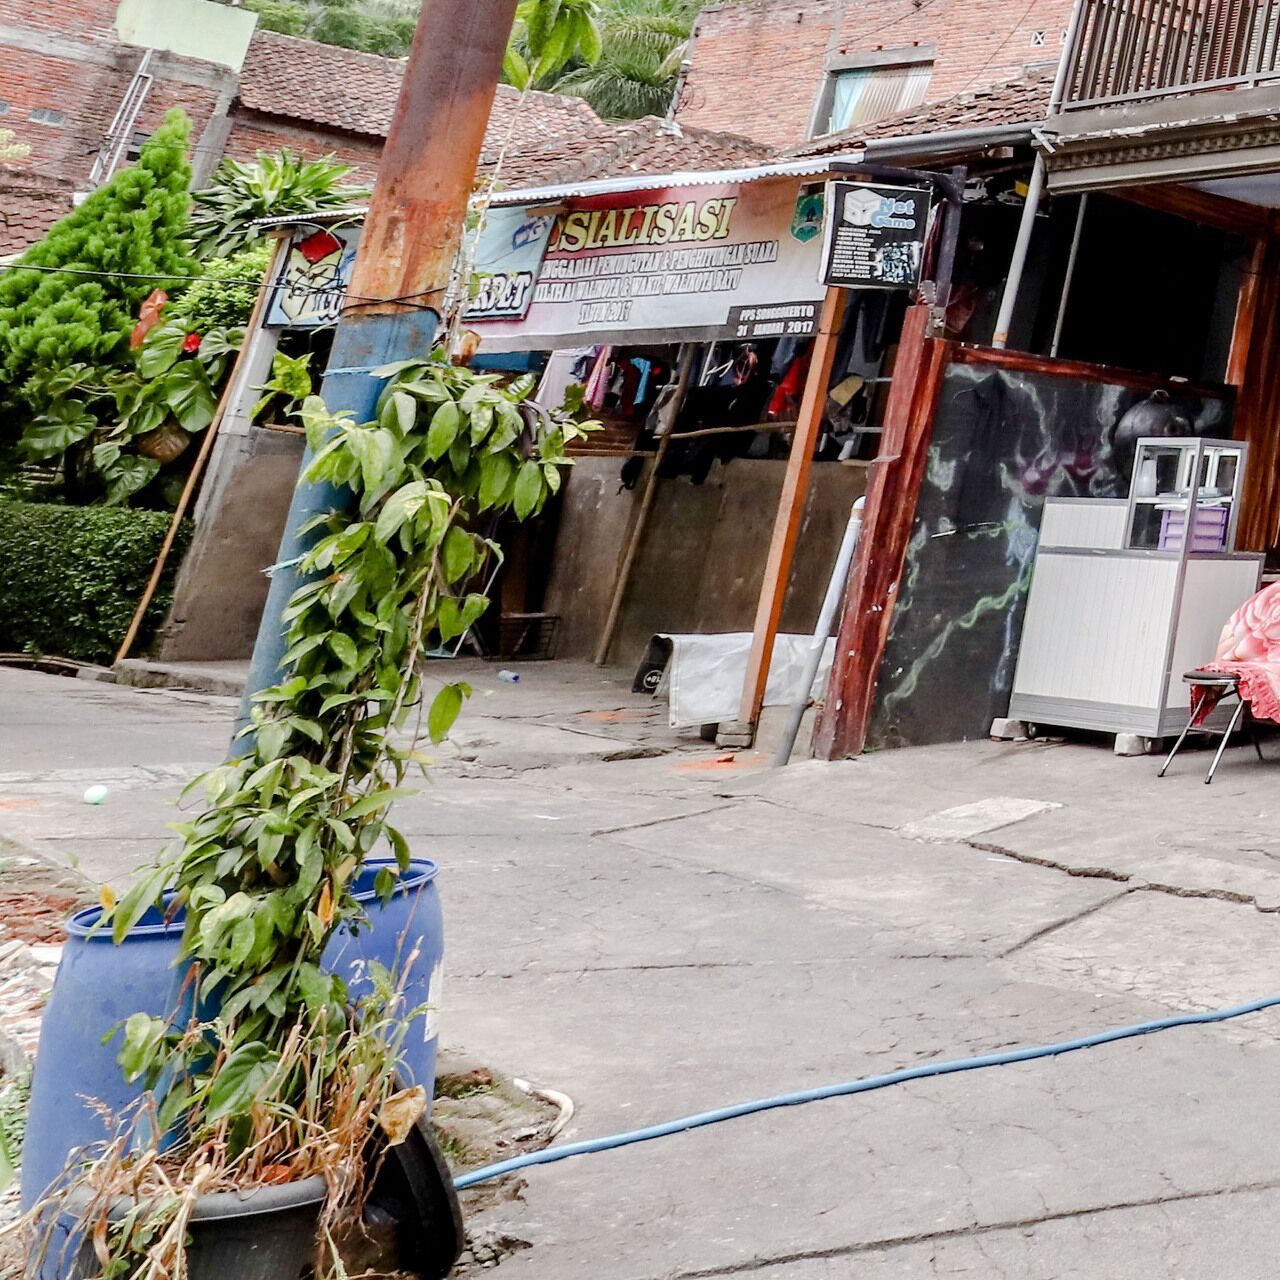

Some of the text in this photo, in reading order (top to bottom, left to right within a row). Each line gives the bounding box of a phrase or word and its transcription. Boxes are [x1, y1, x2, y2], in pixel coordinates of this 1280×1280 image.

[880, 197, 916, 216] Net
[547, 198, 738, 251] SIALISASI
[870, 209, 916, 230] Game
[744, 240, 779, 265] SUARA
[740, 308, 756, 322] PPS
[736, 325, 748, 337] 31
[787, 321, 814, 334] 2017
